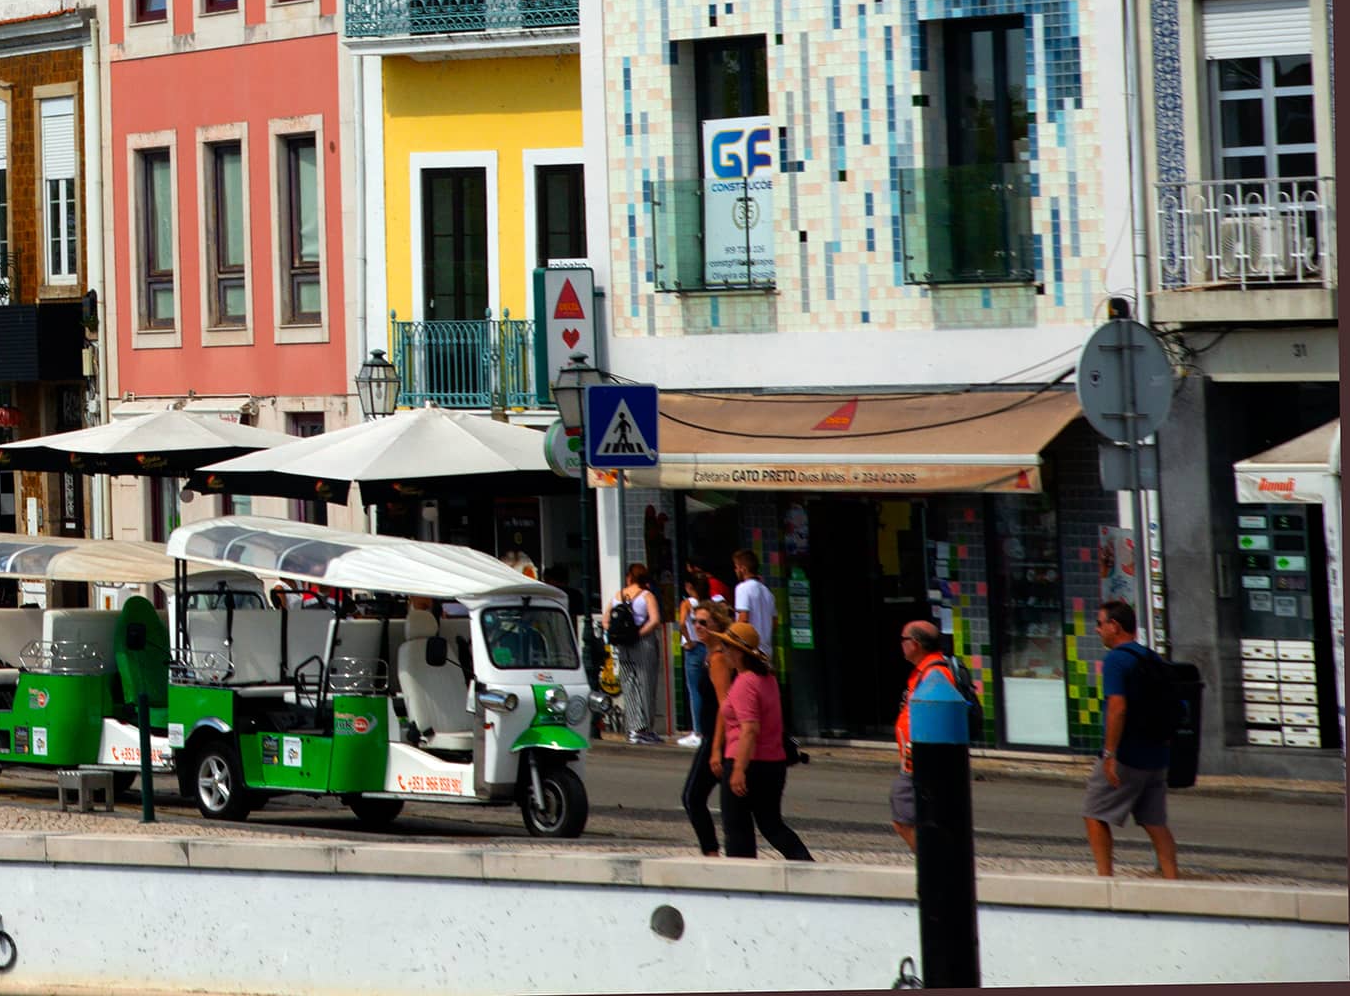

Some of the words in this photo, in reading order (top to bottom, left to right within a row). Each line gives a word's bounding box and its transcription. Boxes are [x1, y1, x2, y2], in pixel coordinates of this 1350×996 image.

[712, 128, 772, 181] GF
[732, 470, 760, 482] GATO
[762, 470, 797, 482] PRETO
